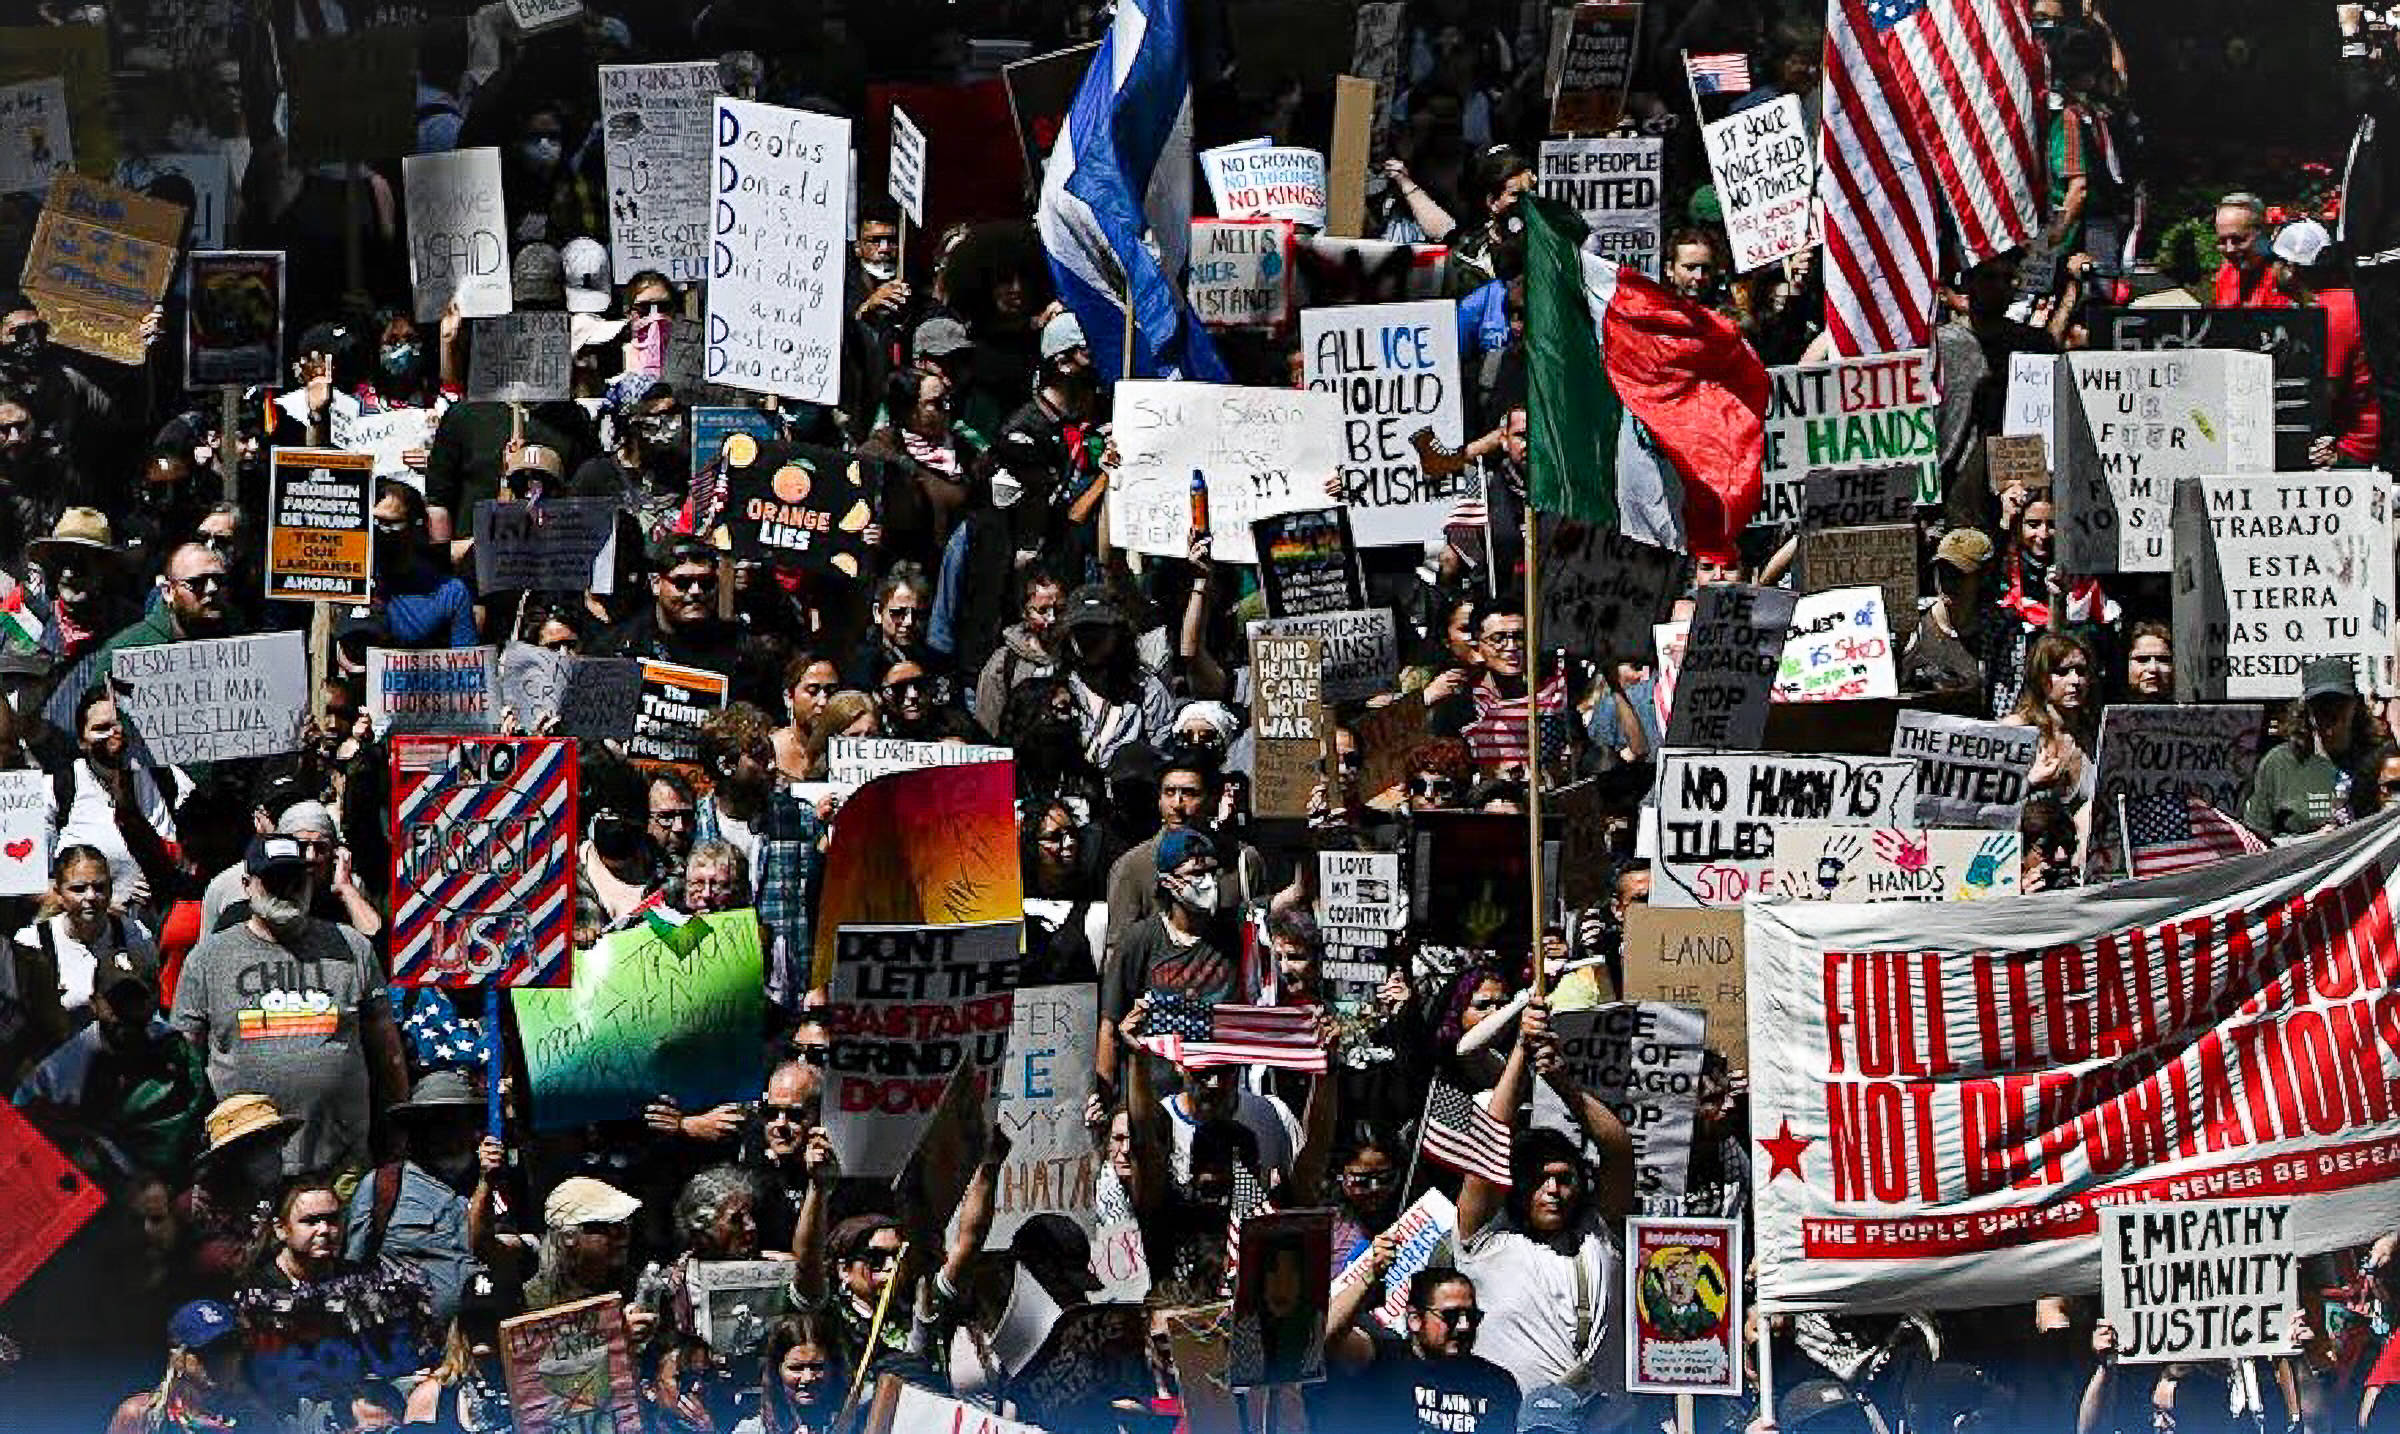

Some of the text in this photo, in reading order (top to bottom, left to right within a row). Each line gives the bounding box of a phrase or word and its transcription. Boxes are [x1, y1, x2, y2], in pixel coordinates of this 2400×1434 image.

[1221, 152, 1319, 174] NO CROWNS
[1544, 152, 1659, 174] THE PEOPLE
[719, 156, 830, 208] Donald
[1544, 178, 1654, 209] UNITED
[1227, 185, 1327, 212] NO KINGS
[1316, 327, 1436, 374] ALL ICE
[1839, 357, 1927, 413] BITE
[1345, 418, 1405, 463] BE
[1806, 406, 1937, 465] HANDS
[2213, 485, 2354, 512] MI TITO
[746, 498, 832, 532] ORANGE
[2207, 513, 2341, 539] TRABAJO
[759, 519, 812, 551] LIES
[2248, 554, 2322, 579] ESTA
[2232, 586, 2338, 610] TIERRA
[2324, 616, 2360, 639] TU
[384, 654, 420, 673] THIS
[424, 654, 442, 673] IS
[1257, 640, 1310, 660] FUND
[383, 671, 489, 692] DEMOCRACY
[1258, 660, 1321, 680] HEALTH
[383, 692, 442, 714] LOOKS
[1260, 678, 1320, 701] CARE
[641, 694, 710, 728] Trump
[1267, 698, 1309, 718] NOT
[1258, 716, 1314, 739] WAR
[1901, 726, 2032, 765] THE PEOPLE
[455, 742, 518, 783] NO
[1680, 762, 1728, 813] NO
[1847, 769, 1884, 818] IS
[1917, 759, 2021, 805] NITED
[410, 815, 540, 880] FASCIST
[1338, 857, 1374, 875] LOVE
[1867, 866, 1946, 894] HANDS
[1328, 903, 1390, 926] COUNTRY
[432, 915, 541, 974] USA
[1661, 933, 1734, 966] LAND
[1824, 864, 2400, 1077] FULL LEGALIZATION
[1593, 1010, 1658, 1040] ICE
[1638, 1043, 1685, 1068] OF
[1825, 1080, 1940, 1204] NOT
[1806, 1222, 1858, 1246] THE
[1865, 1217, 1970, 1244] PEOPLE
[1978, 1199, 2084, 1238] UNITED
[2096, 1184, 2167, 1208] WILL
[2170, 1167, 2263, 1202] NEVER
[2272, 1160, 2310, 1184] BE
[2117, 1204, 2291, 1266] EMPATHY
[2120, 1251, 2294, 1310] HUMANITY
[2116, 1302, 2284, 1358] JUSTICE
